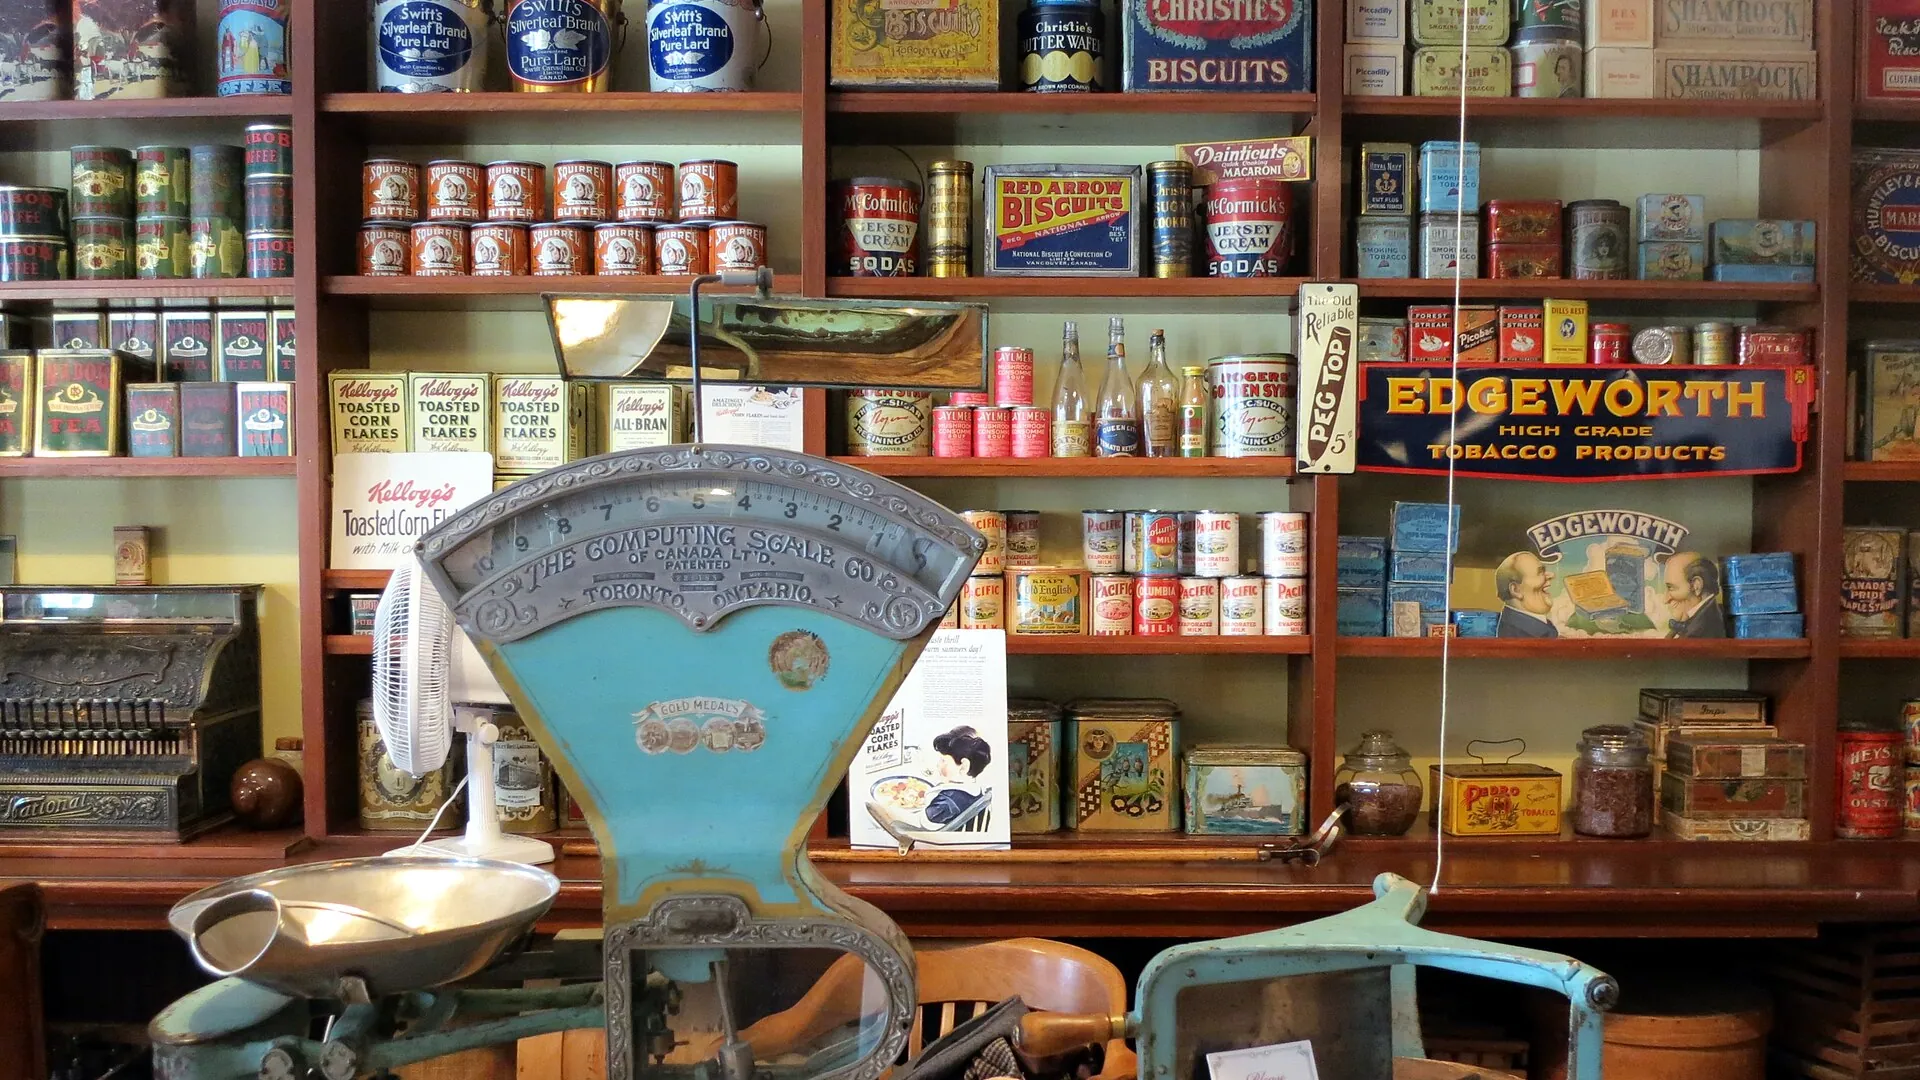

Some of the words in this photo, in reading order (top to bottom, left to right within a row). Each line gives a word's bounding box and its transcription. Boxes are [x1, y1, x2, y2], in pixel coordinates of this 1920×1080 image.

[401, 7, 442, 22] Swift's
[665, 10, 702, 24] Swift's
[1359, 6, 1392, 15] Piccadilly
[436, 21, 467, 39] Brand
[566, 16, 600, 33] Brand
[696, 25, 728, 38] Brand
[1036, 20, 1092, 34] Christie's
[394, 36, 421, 48] Pure
[423, 37, 449, 49] Lard
[660, 40, 682, 52] Pure
[684, 38, 710, 50] Lard
[521, 54, 551, 68] Pure
[553, 53, 586, 68] Lard
[1148, 59, 1289, 84] BISCUITS
[1356, 68, 1390, 77] Piccadilly
[1194, 144, 1287, 167] Dainticuts
[370, 165, 418, 183] SQUIRREL
[431, 166, 478, 185] SQUIRREL
[488, 166, 533, 184] SQUIRREL
[1223, 166, 1281, 177] MACARONI
[1003, 181, 1042, 194] RED
[1047, 181, 1123, 194] ARROW
[1904, 174, 1913, 188] &
[371, 207, 418, 218] BUTTER
[431, 207, 479, 218] BUTTER
[558, 206, 606, 217] BUTTER
[618, 206, 665, 218] BUTTER
[1002, 197, 1123, 229] BISCUITS
[1006, 236, 1022, 244] RED
[1035, 220, 1089, 238] NATIONAL
[1095, 211, 1122, 223] ARROW
[1215, 225, 1274, 237] JERSEY
[863, 235, 909, 250] CREAM
[1219, 238, 1269, 252] CREAM
[850, 257, 914, 272] SODAS
[1209, 259, 1277, 275] SODAS
[1332, 295, 1352, 306] Old
[168, 321, 211, 340] NABOB
[222, 321, 266, 340] NABOB
[1306, 308, 1354, 345] Reliable
[1459, 326, 1494, 346] Picobac
[998, 352, 1032, 362] AYLMER
[1322, 339, 1346, 385] TOP
[173, 360, 207, 370] TEA
[227, 360, 264, 370] TEA
[45, 361, 110, 391] NABOB
[339, 381, 398, 402] Kellogg's
[420, 380, 478, 401] Kellogg's
[502, 380, 558, 401] Kellogg's
[1386, 376, 1766, 418] EDGEWORTH
[339, 403, 400, 413] TOASTED
[418, 401, 480, 412] TOASTED
[500, 402, 560, 413] TOASTED
[617, 397, 664, 416] Kellogg's
[350, 416, 390, 426] CORN
[429, 415, 469, 426] CORN
[510, 415, 549, 426] CORN
[1310, 391, 1336, 443] PEG
[48, 418, 104, 434] TEA
[614, 418, 667, 431] ALL-BRAN
[1102, 425, 1126, 433] QUEEN
[1499, 425, 1560, 436] HIGH
[1574, 426, 1653, 437] GRADE
[188, 434, 225, 444] TEA
[248, 434, 284, 444] TEA
[344, 428, 399, 439] FLAKES
[422, 427, 477, 438] FLAKES
[503, 427, 557, 438] FLAKES
[857, 426, 900, 444] REFINING
[1426, 444, 1557, 460] TOBACCO
[1576, 446, 1726, 461] PRODUCTS
[368, 480, 456, 507] Kellogg's
[343, 509, 396, 536] Toasted
[398, 509, 428, 536] Corn
[1088, 518, 1122, 533] PACIFIC
[472, 557, 494, 577] 10
[514, 535, 530, 552] 9
[557, 517, 572, 535] 8
[601, 504, 613, 522] 7
[646, 496, 660, 512] 6
[692, 493, 705, 509] 5
[737, 495, 752, 511] 4
[783, 503, 798, 519] 3
[827, 514, 843, 532] 2
[873, 532, 883, 547] 1
[1533, 512, 1684, 549] EDGEWORTH
[1156, 536, 1176, 544] MILK
[352, 542, 376, 555] with
[378, 541, 398, 555] Milk
[628, 551, 647, 564] OF
[655, 546, 723, 560] CANADA
[526, 547, 577, 593] THE
[585, 525, 735, 561] COMPUTING
[747, 530, 836, 568] SCALE
[843, 556, 874, 583] CO
[665, 560, 731, 570] PATENTED
[963, 583, 999, 598] PACIFIC
[1039, 585, 1072, 596] English
[1095, 581, 1133, 599] PACIFIC
[1136, 583, 1176, 599] COLUMBIA
[1842, 581, 1895, 591] CANADA'S
[1850, 591, 1885, 600] PRIDE
[1138, 624, 1174, 633] MILK
[943, 634, 960, 644] thrill
[661, 703, 690, 716] GOLD
[693, 699, 740, 713] MEDALS
[871, 732, 895, 744] CORN
[867, 740, 899, 754] FLAKES
[1466, 784, 1521, 811] PEDRO
[2, 793, 88, 820] National
[1521, 808, 1557, 817] TOBACCO
